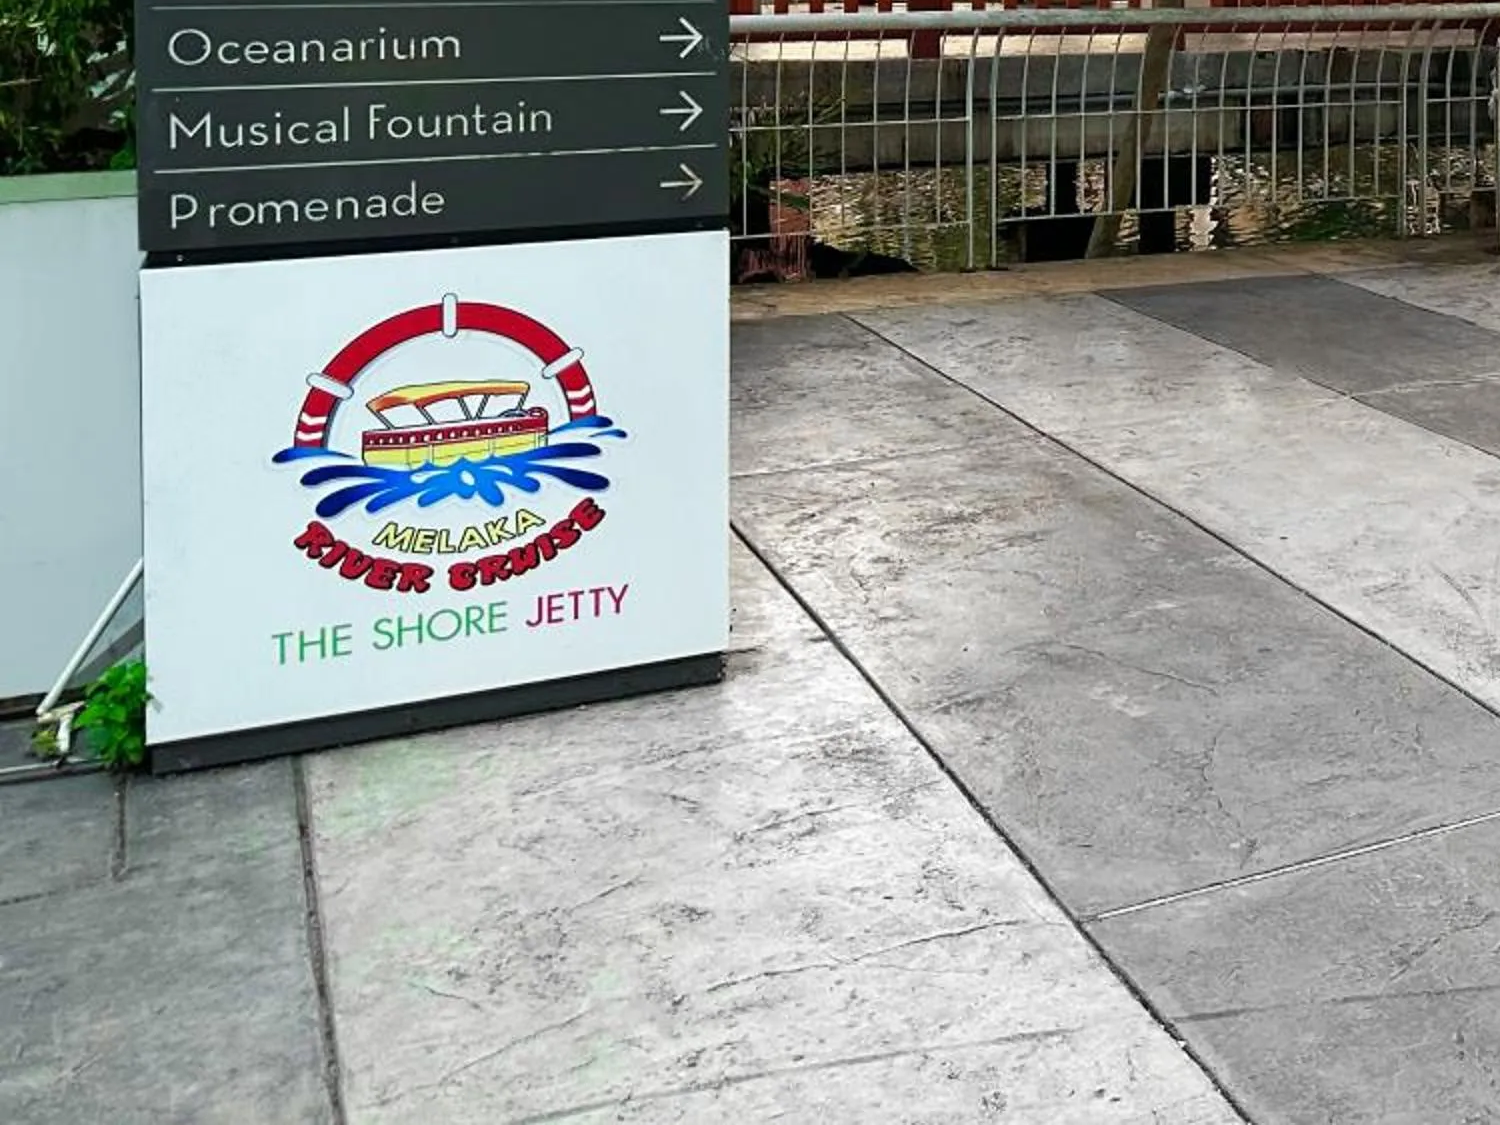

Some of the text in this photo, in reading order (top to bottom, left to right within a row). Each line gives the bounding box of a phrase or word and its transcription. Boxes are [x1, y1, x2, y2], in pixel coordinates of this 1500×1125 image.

[167, 27, 462, 67] Oceanarium
[169, 100, 553, 150] Musical Fountain
[170, 181, 445, 230] Promenade
[293, 496, 607, 593] RIVER CRUISE
[372, 508, 546, 555] MELAKA
[271, 583, 630, 666] THE SHORE JETTY
